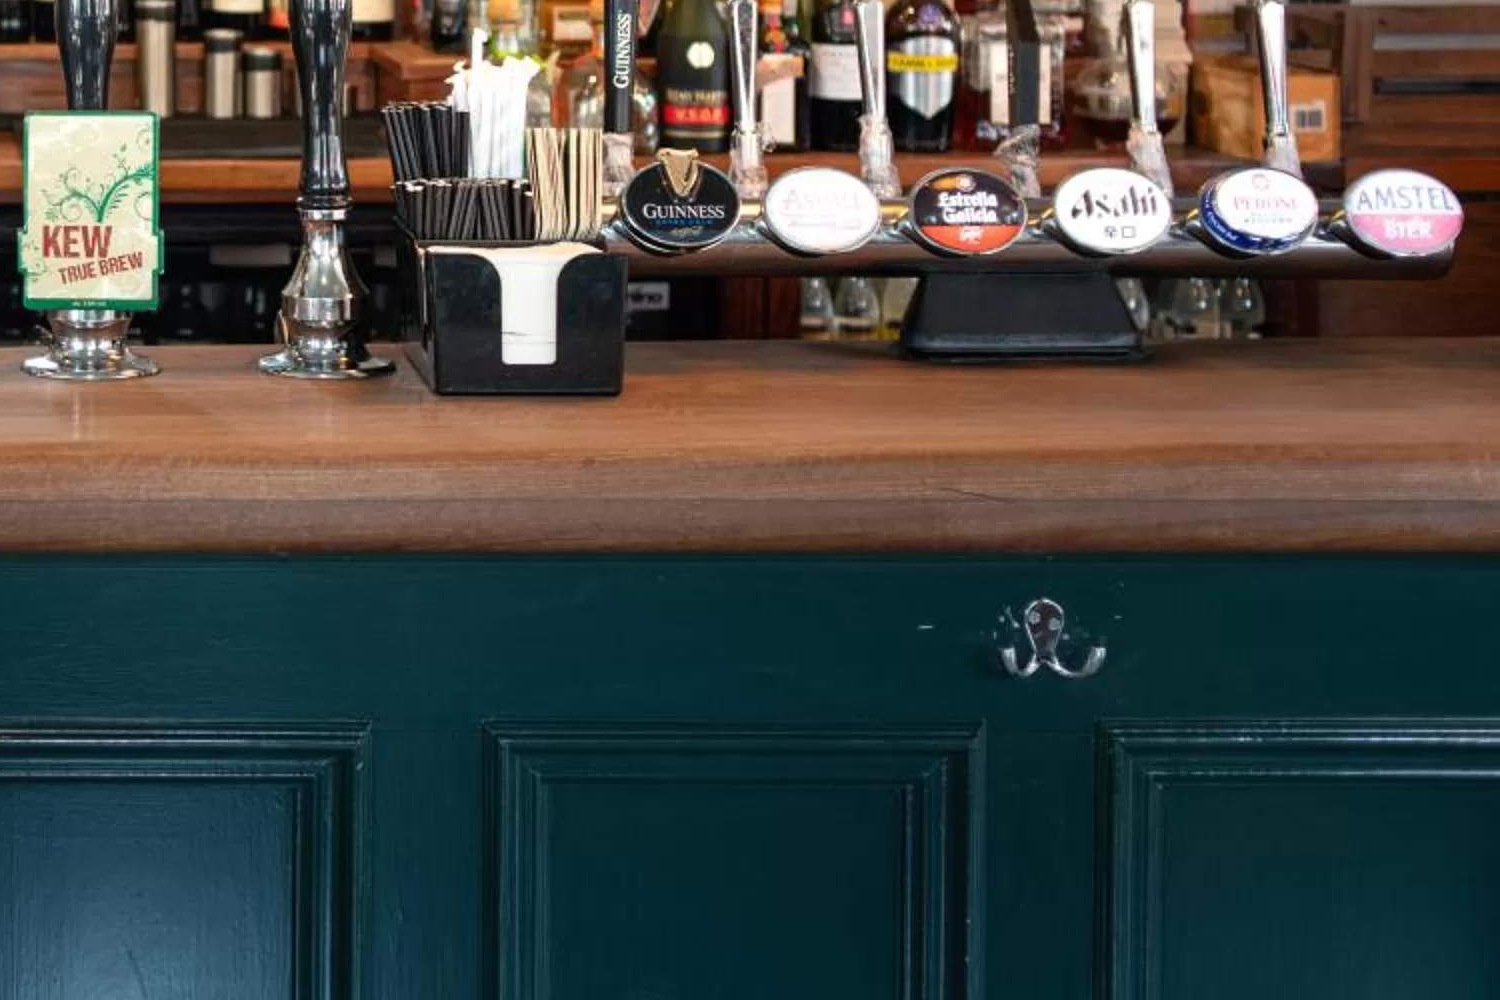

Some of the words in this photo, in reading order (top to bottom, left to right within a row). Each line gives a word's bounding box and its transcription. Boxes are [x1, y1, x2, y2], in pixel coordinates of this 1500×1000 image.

[613, 11, 632, 89] GUINNESS
[642, 203, 725, 219] GUINNESS
[938, 191, 998, 207] Estrella
[1071, 185, 1157, 219] Asahi
[1357, 186, 1455, 211] AMSTEL
[941, 207, 998, 224] Galicia
[42, 225, 113, 258] KEW
[1384, 220, 1433, 239] BIER
[57, 261, 98, 285] TRUE
[99, 251, 144, 279] BREW
